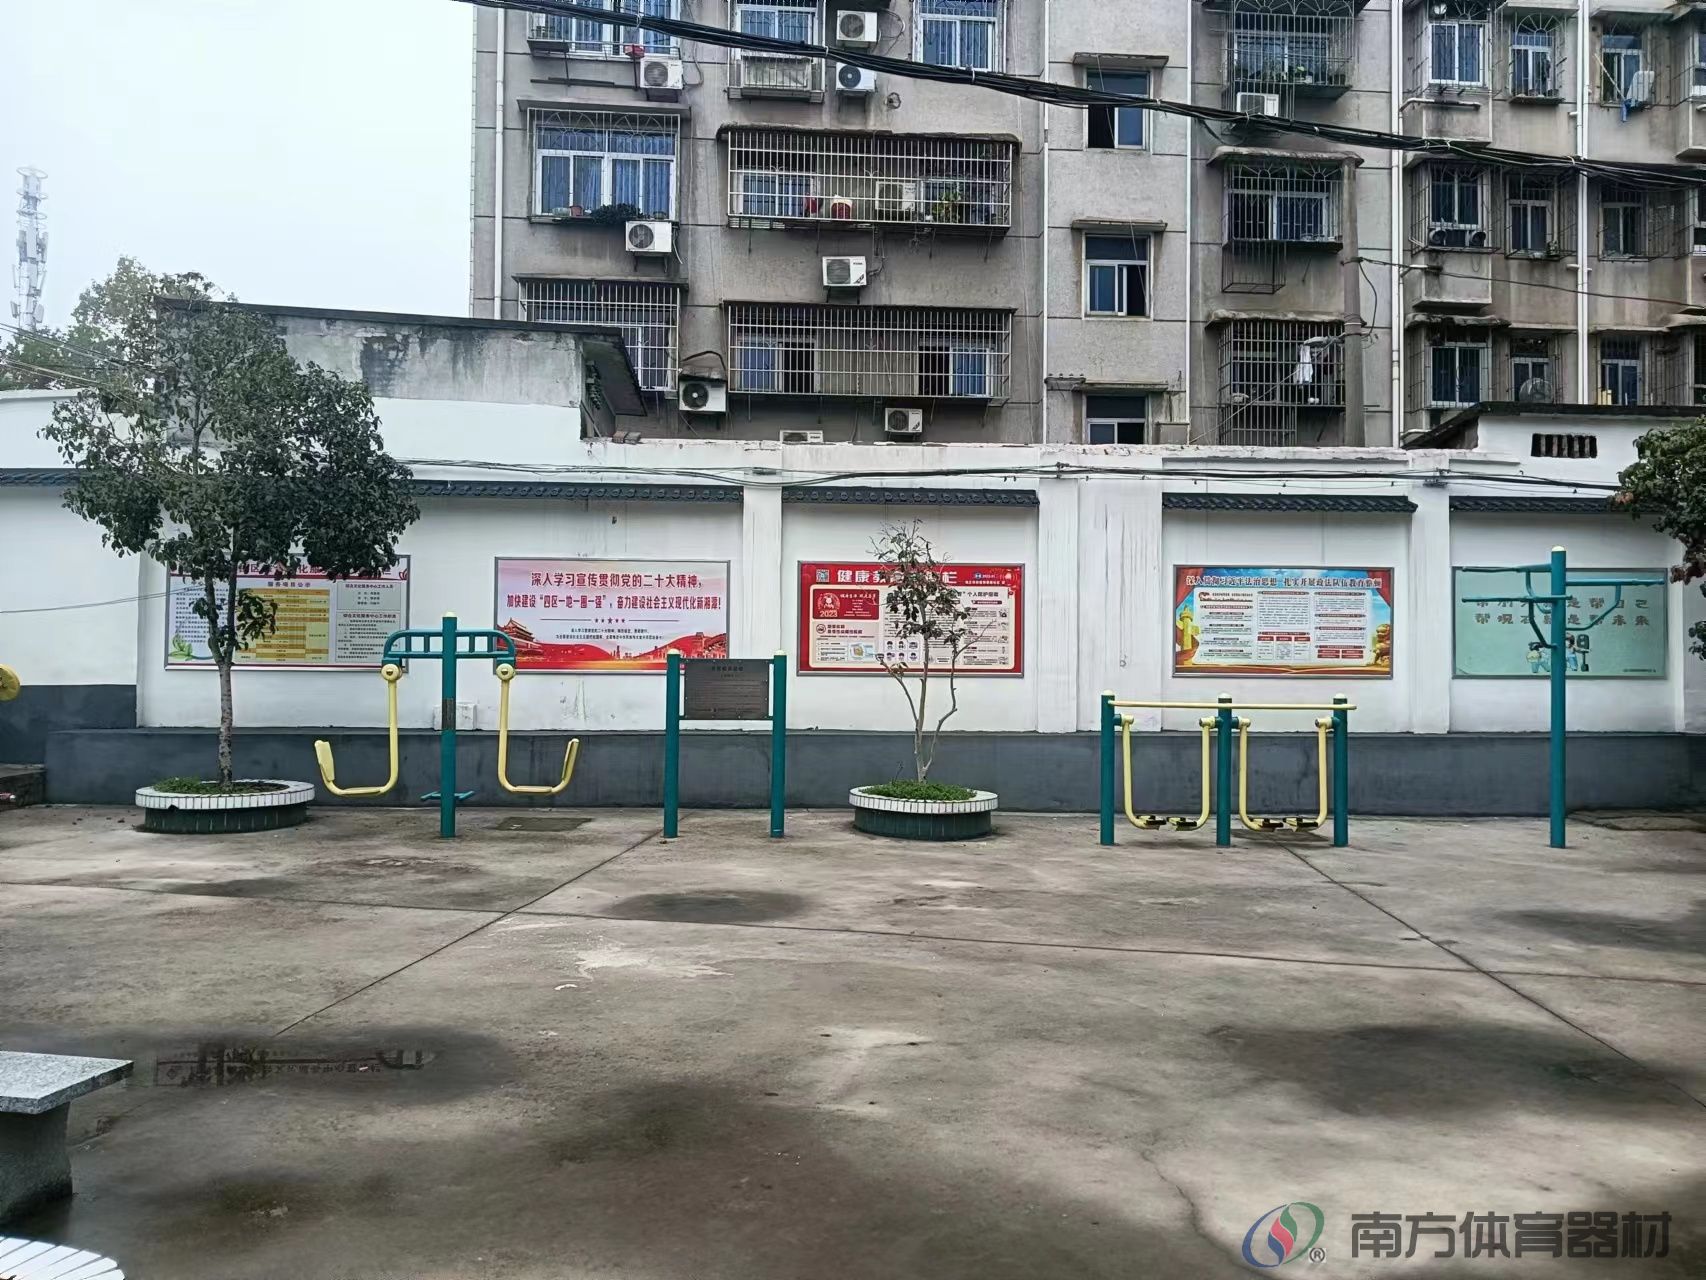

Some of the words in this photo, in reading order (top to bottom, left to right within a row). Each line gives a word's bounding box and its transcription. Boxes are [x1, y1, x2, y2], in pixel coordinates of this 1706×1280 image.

[531, 573, 702, 588] 深入学习宣传贯彻党的二十大精神，
